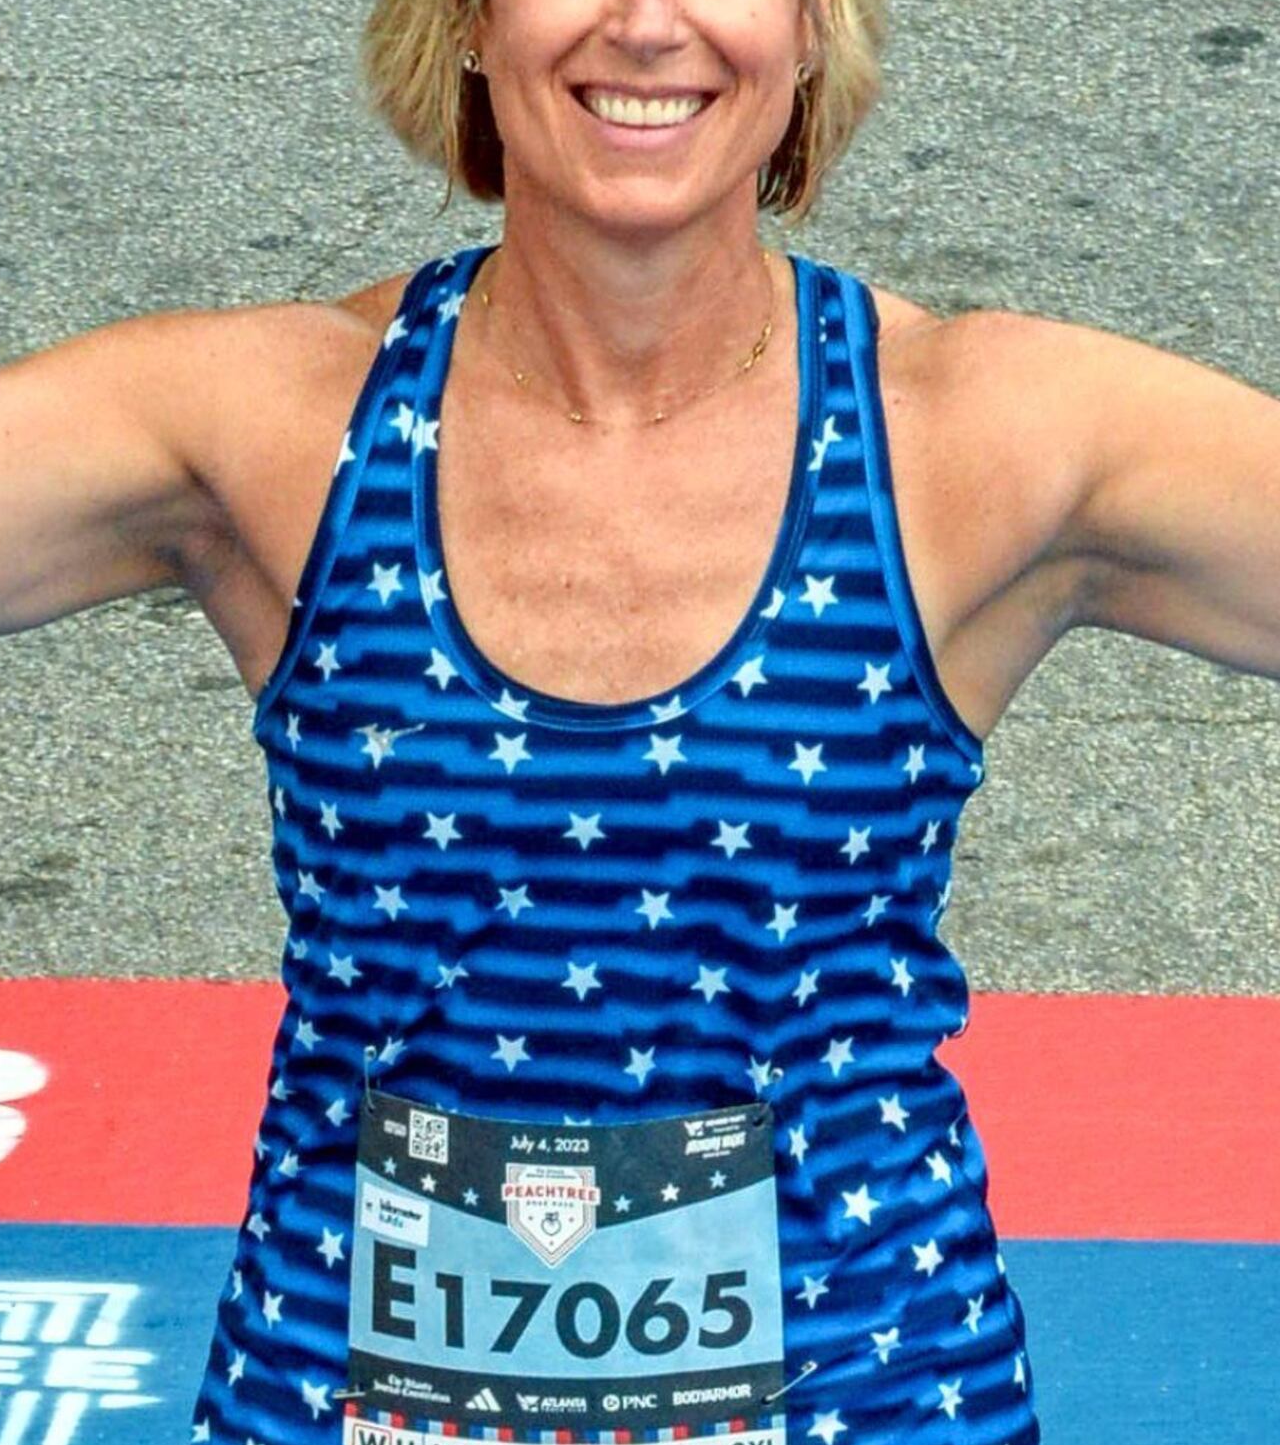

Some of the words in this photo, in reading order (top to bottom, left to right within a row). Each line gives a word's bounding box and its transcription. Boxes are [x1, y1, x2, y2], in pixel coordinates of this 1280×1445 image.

[510, 1134, 536, 1154] July
[554, 1137, 591, 1153] 2023
[504, 1184, 598, 1202] PEACHTREE
[371, 1241, 754, 1360] E17065
[621, 1393, 658, 1409] PNC
